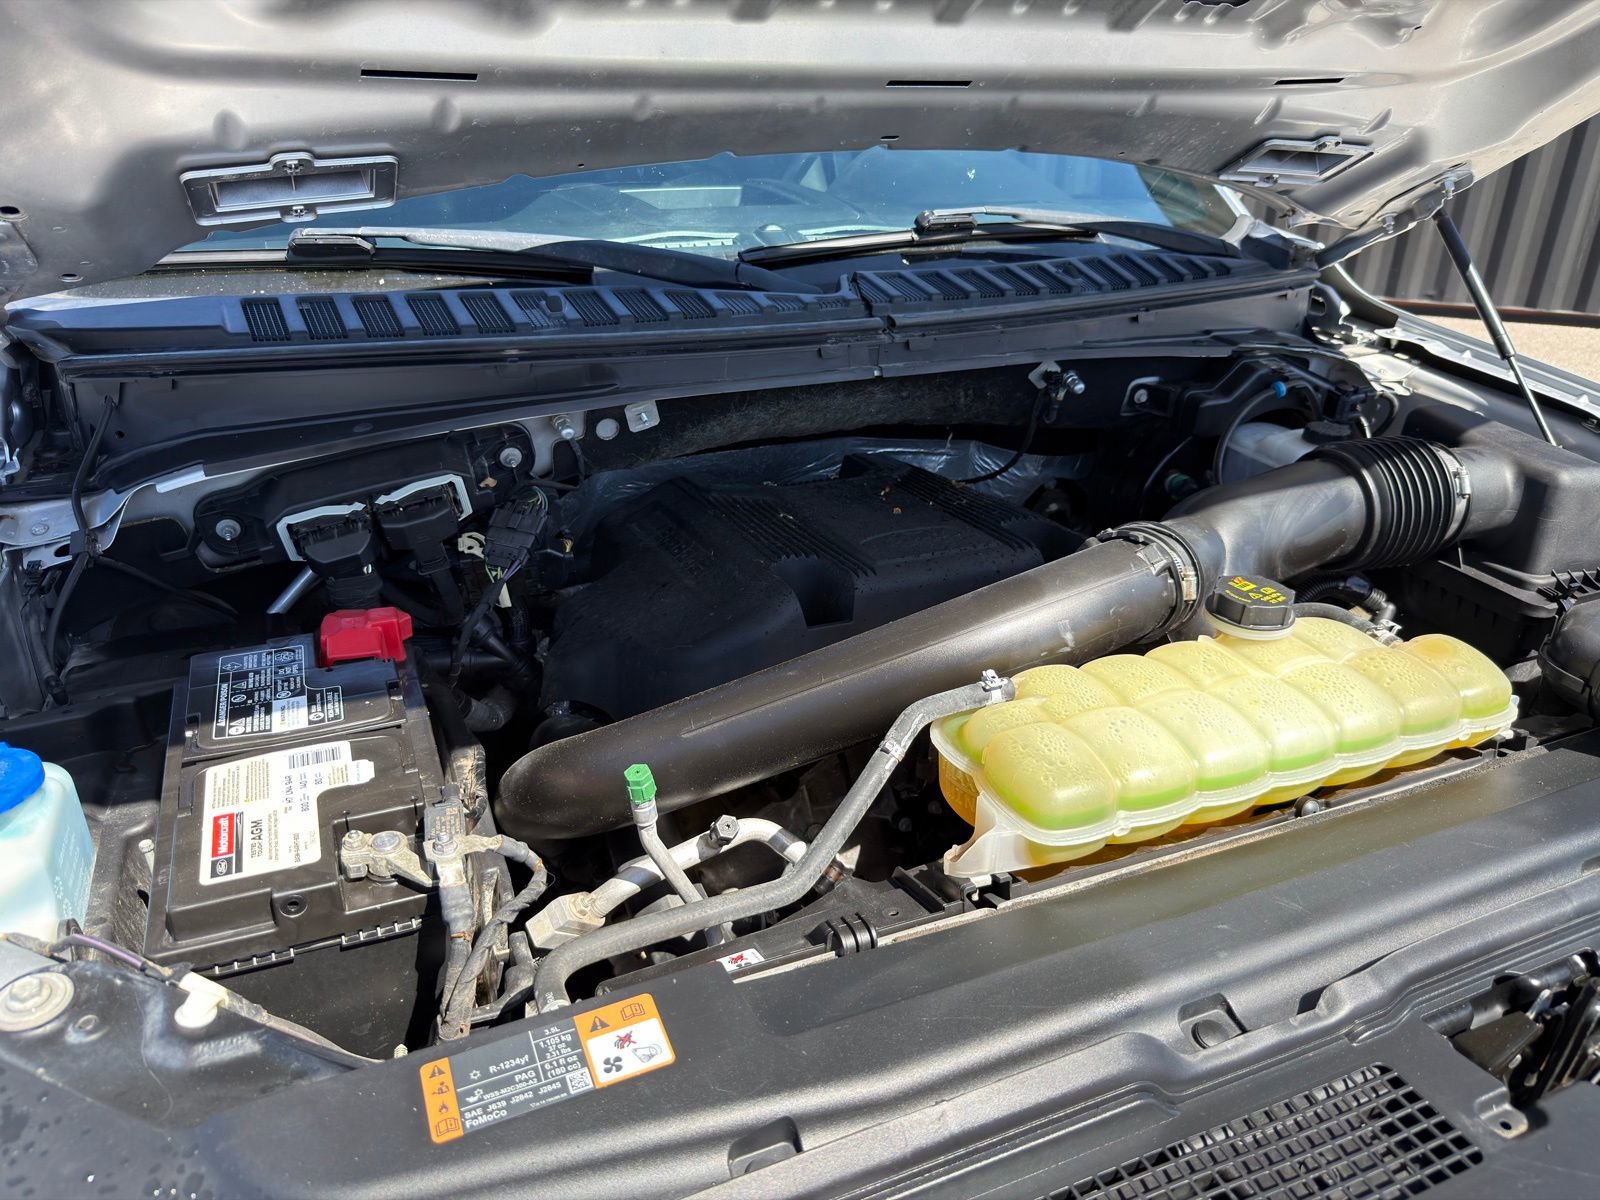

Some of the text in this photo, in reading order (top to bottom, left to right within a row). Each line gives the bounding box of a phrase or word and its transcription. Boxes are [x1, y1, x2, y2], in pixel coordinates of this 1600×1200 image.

[217, 817, 229, 855] Motorcraft
[251, 819, 262, 840] AGM
[544, 1026, 560, 1036] 3.5L
[540, 1033, 572, 1048] 1.105 kg
[545, 1047, 571, 1059] 2.31 lbs
[489, 1054, 529, 1074] R-1234yf
[544, 1055, 578, 1070] 6.1 fl oz
[547, 1061, 581, 1079] (180 cc)
[514, 1070, 536, 1083] PAG
[464, 1108, 483, 1120] SAE
[487, 1100, 507, 1112] J639
[510, 1091, 534, 1104] J2842
[465, 1109, 508, 1129] FoMoCo
